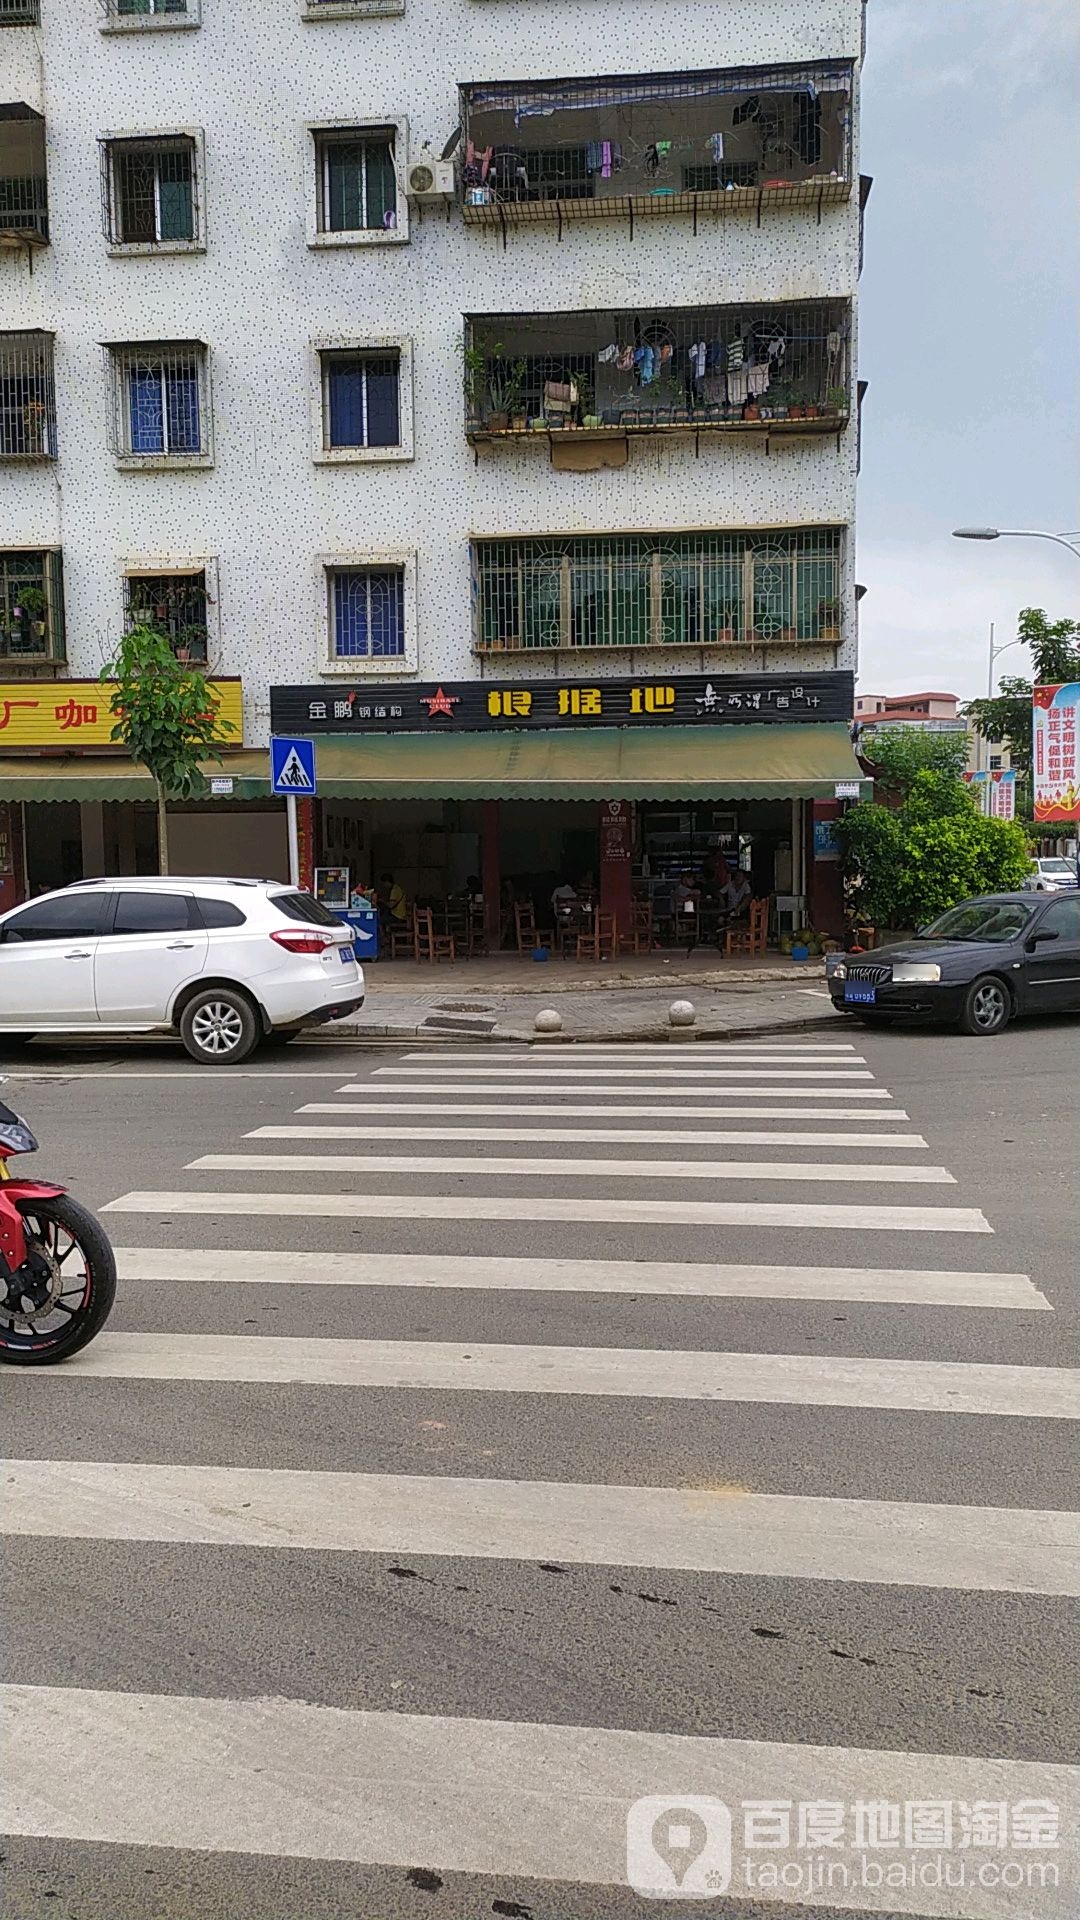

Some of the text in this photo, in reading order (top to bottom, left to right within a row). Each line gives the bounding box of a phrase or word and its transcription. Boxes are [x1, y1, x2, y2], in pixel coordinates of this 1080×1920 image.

[488, 687, 675, 717] 根据地
[1047, 708, 1061, 781] 扬正气促和谐
[1062, 706, 1076, 780] 讲文明树新风
